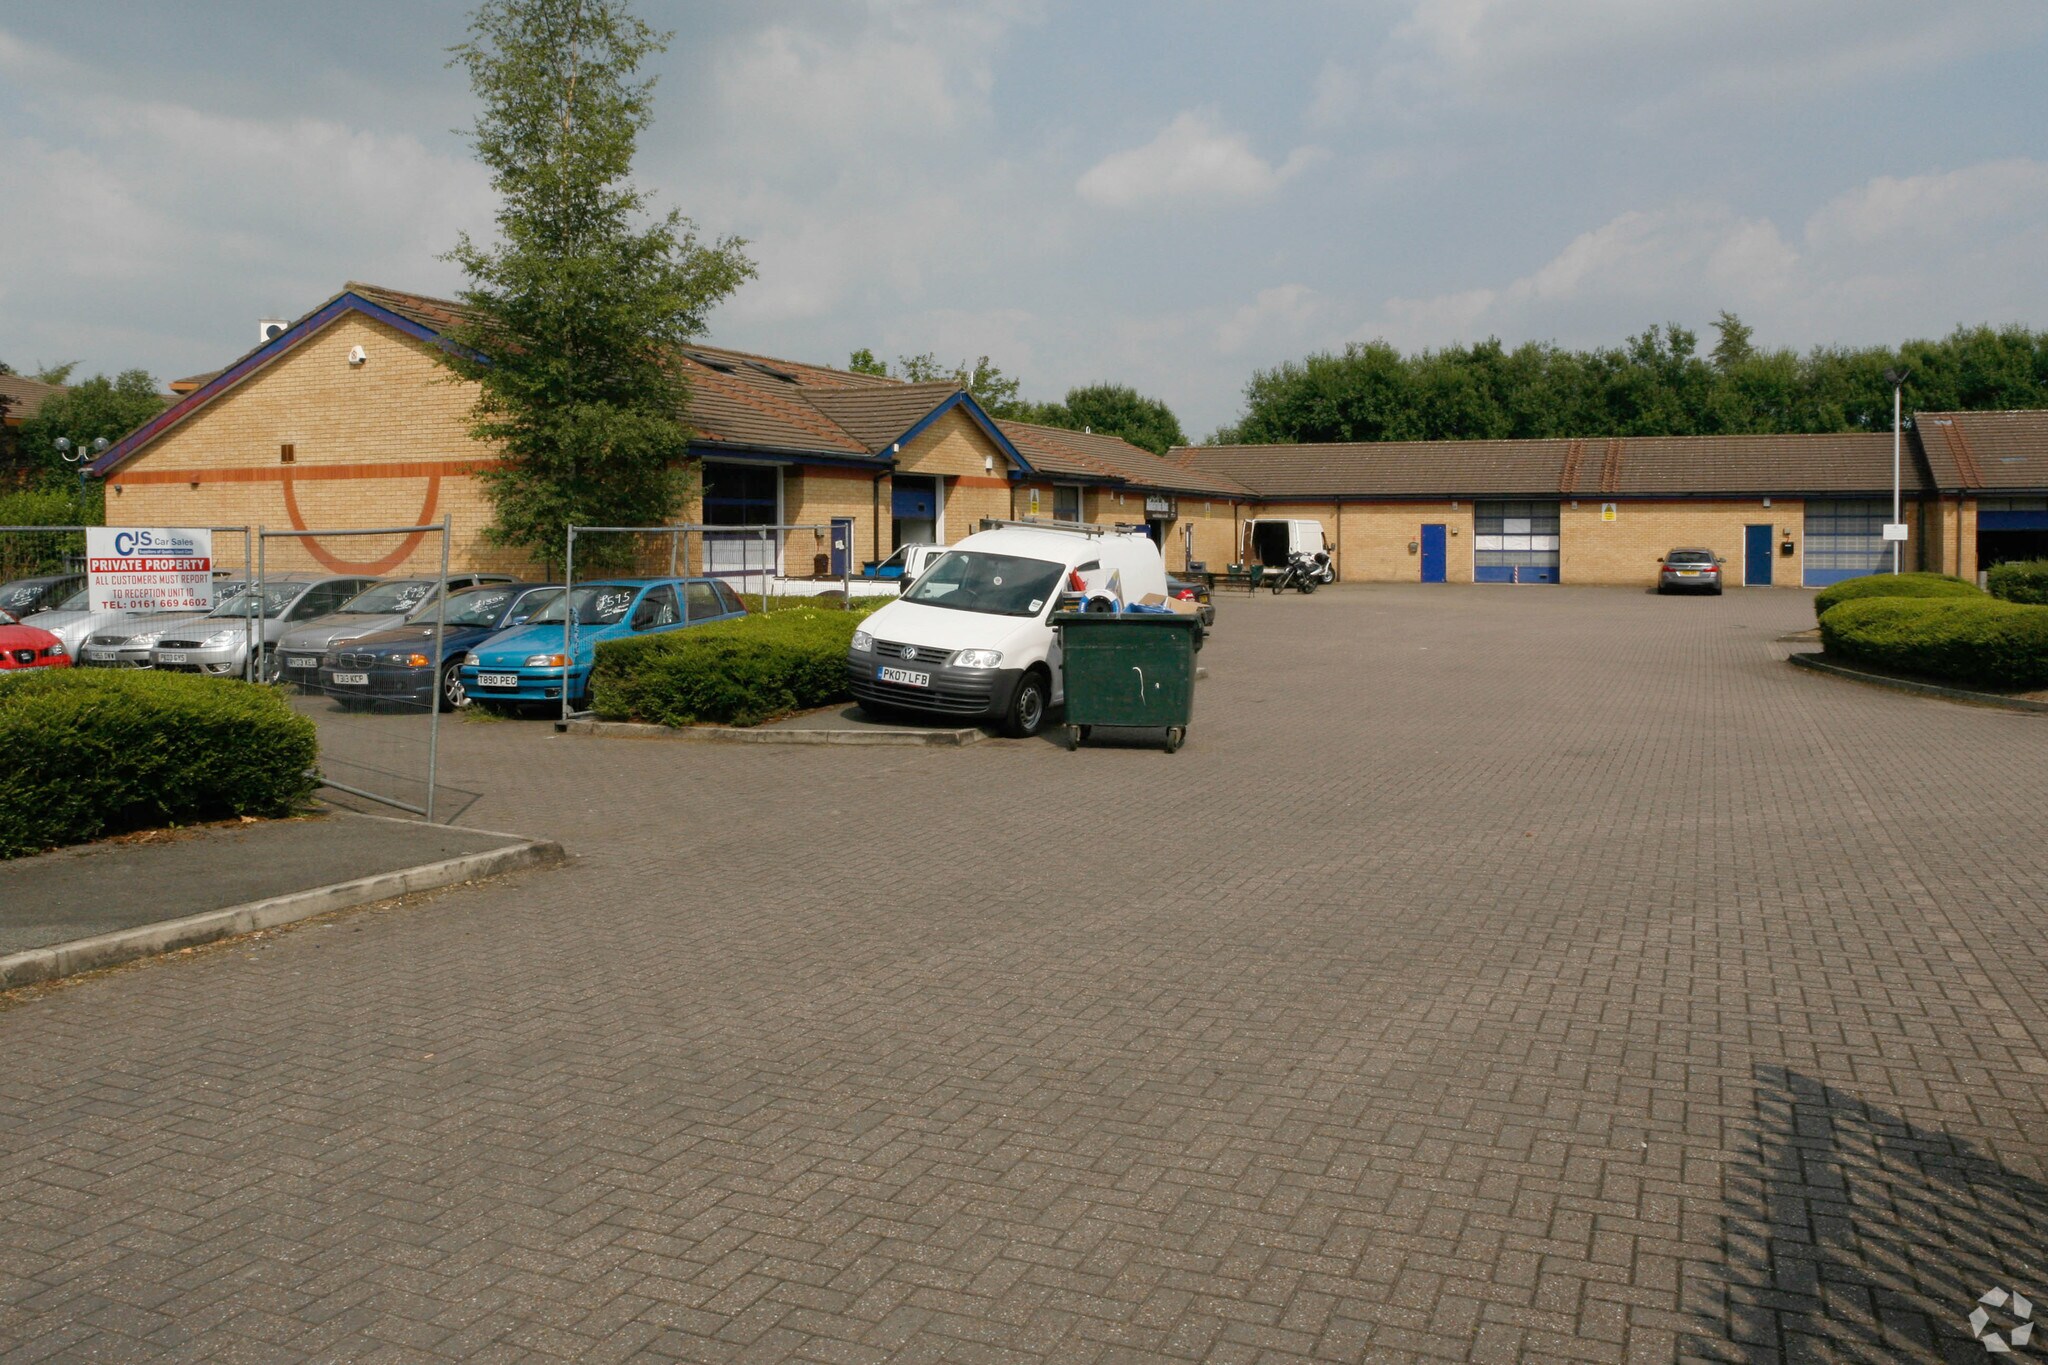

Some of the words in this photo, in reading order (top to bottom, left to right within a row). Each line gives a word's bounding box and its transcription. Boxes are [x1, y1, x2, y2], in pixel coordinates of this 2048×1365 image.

[115, 531, 152, 556] CJS
[154, 538, 169, 546] Car
[171, 538, 194, 546] Sales
[91, 560, 143, 571] PRIVATE
[145, 559, 205, 571] PROPERTY
[95, 576, 109, 586] ALL
[111, 575, 158, 585] CUSTOMERS
[159, 574, 179, 584] MUST
[181, 574, 209, 584] REPORT
[113, 589, 123, 599] TO
[125, 588, 166, 598] RECEPTION
[168, 587, 184, 597] UNIT
[186, 587, 194, 597] 10
[102, 601, 127, 610] TEL:
[130, 600, 156, 609] 0161
[160, 599, 179, 608] 669
[182, 598, 207, 607] 4602
[479, 675, 498, 684] T890
[883, 668, 907, 682] PK07
[908, 672, 928, 685] LFB
